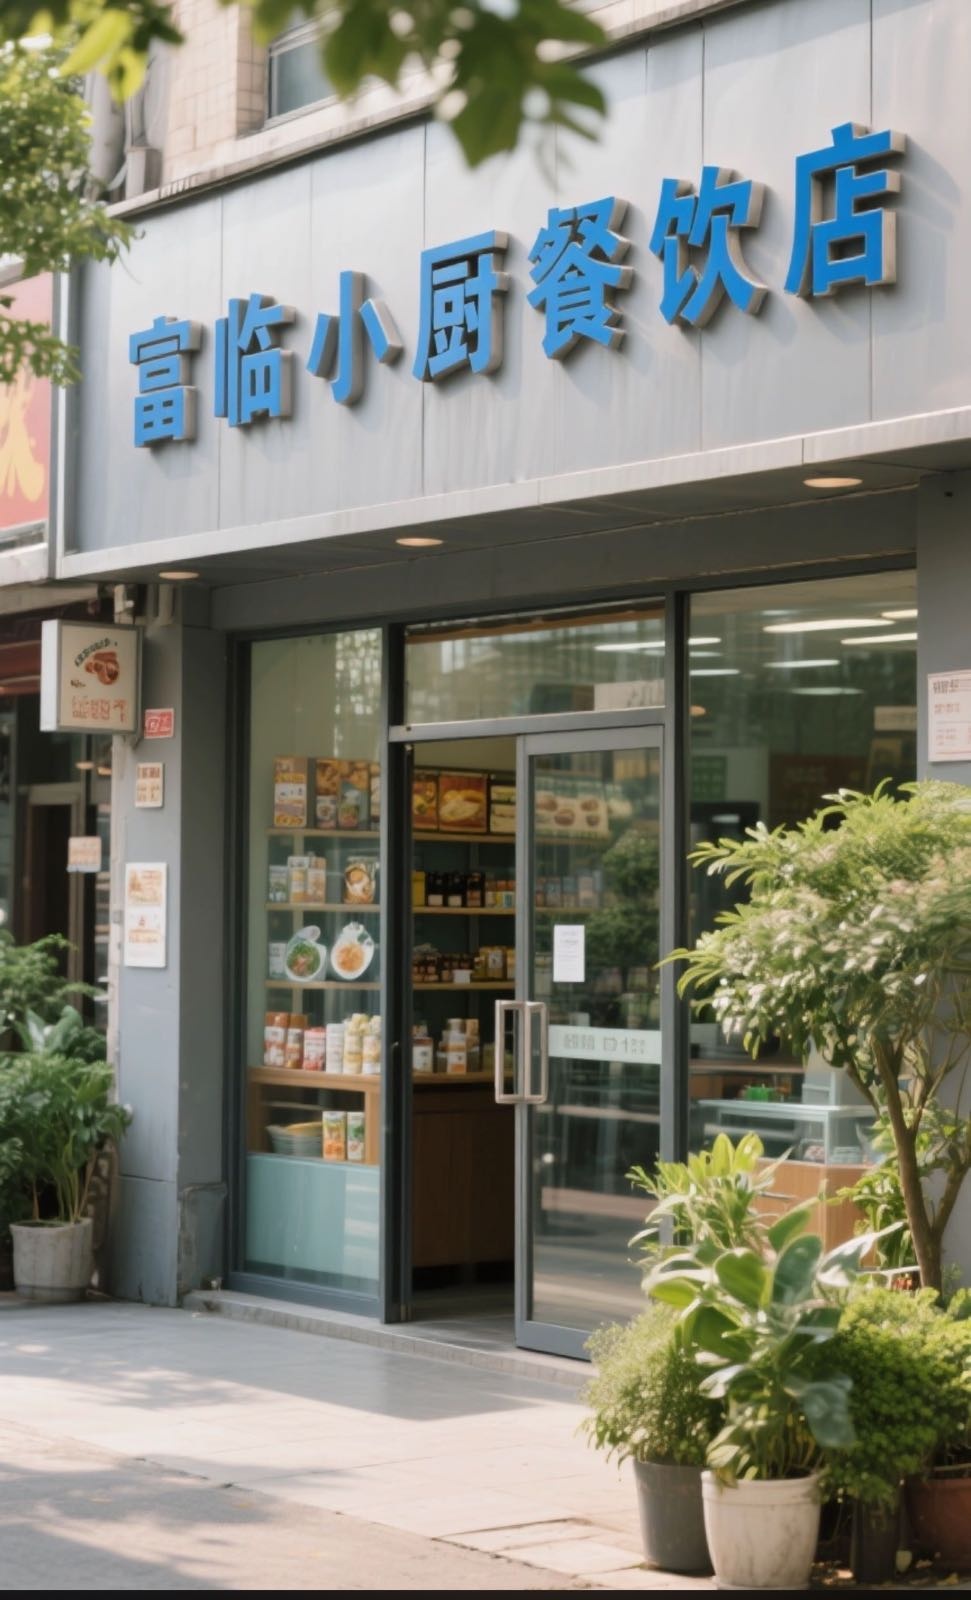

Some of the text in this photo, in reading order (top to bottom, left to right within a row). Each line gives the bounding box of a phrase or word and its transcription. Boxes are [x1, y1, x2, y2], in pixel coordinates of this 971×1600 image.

[128, 122, 905, 448] 富临小厨餐饮店
